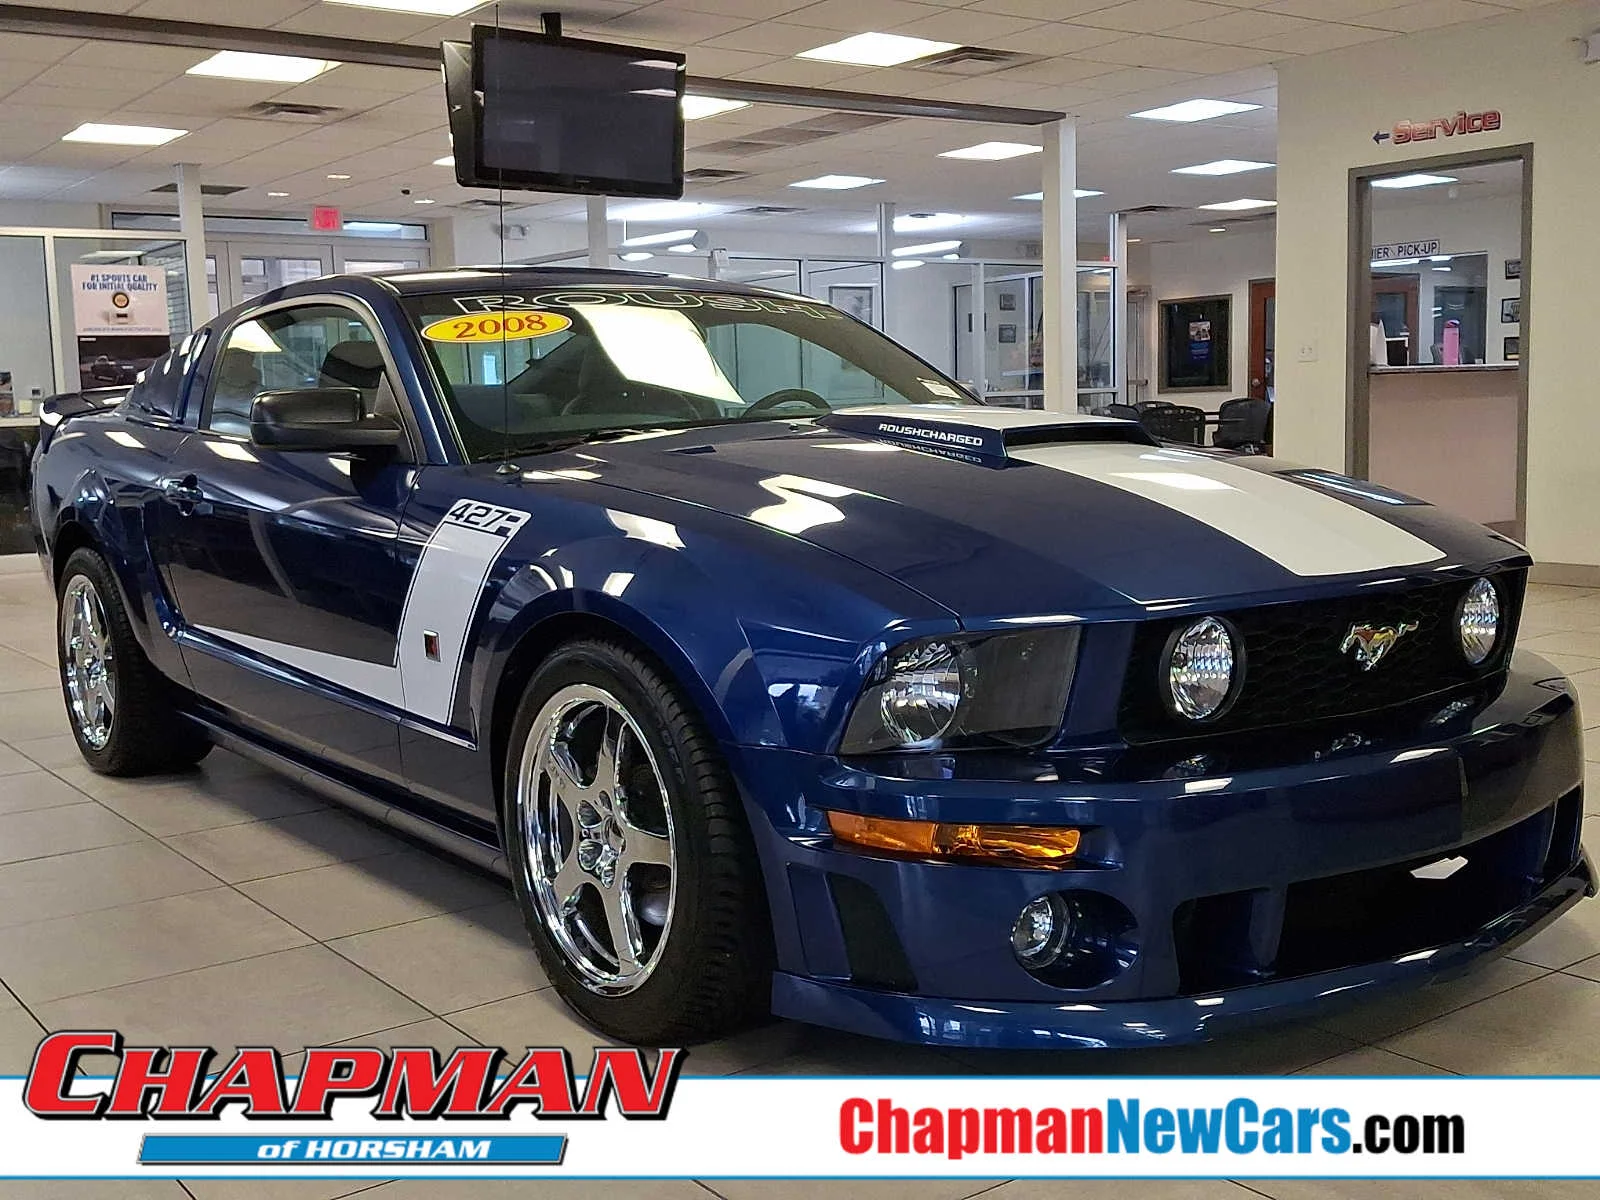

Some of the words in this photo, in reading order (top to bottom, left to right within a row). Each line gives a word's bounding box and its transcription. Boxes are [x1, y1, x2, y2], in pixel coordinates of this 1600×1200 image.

[1392, 110, 1501, 144] Service
[1397, 242, 1438, 257] PICK-UP
[99, 282, 125, 290] INITIAL
[127, 283, 158, 291] QUALITY
[452, 314, 548, 339] 2008
[878, 423, 983, 447] ROUSHCHARGED
[449, 502, 512, 528] 427
